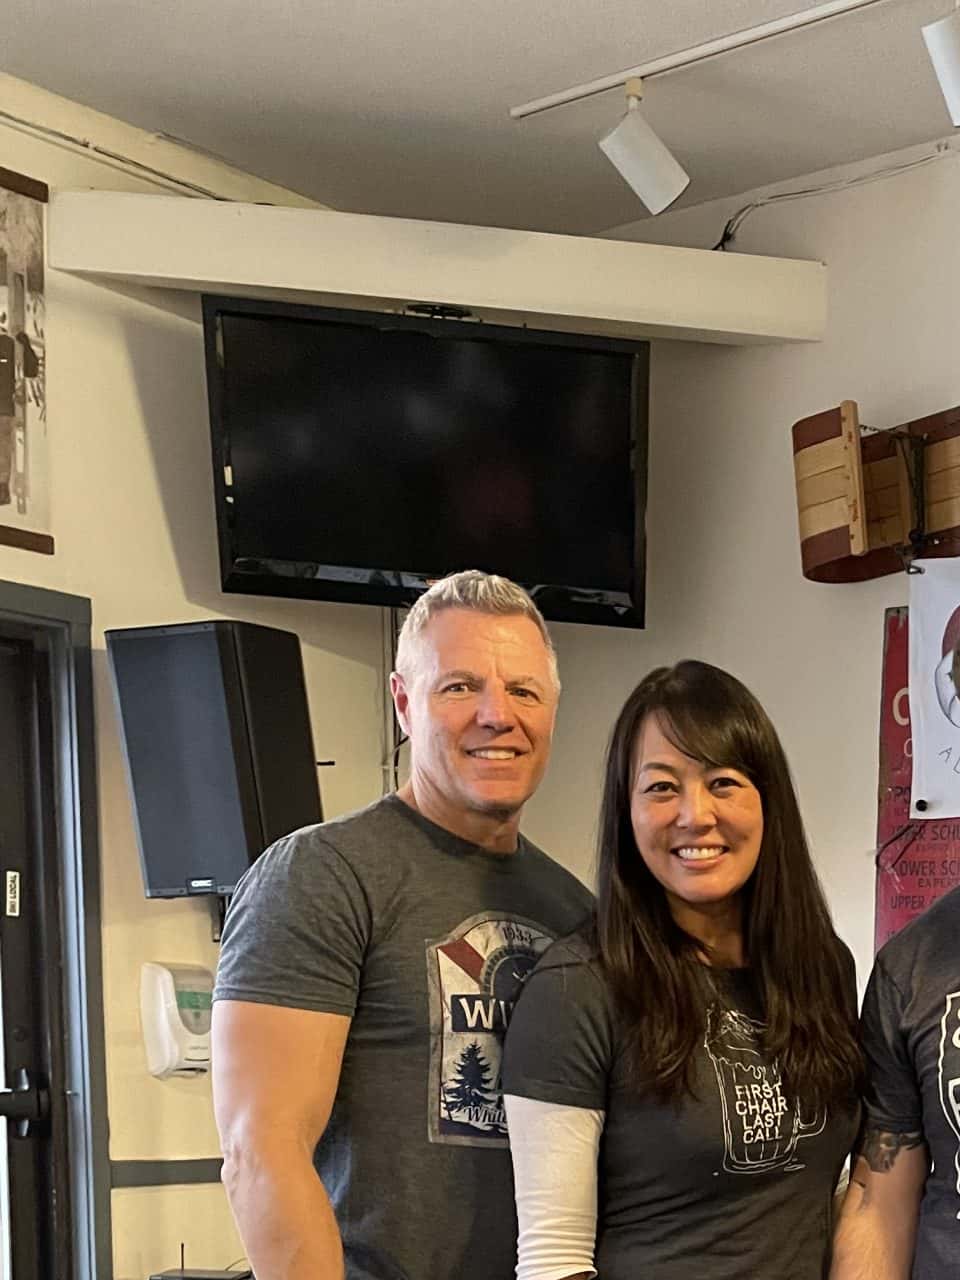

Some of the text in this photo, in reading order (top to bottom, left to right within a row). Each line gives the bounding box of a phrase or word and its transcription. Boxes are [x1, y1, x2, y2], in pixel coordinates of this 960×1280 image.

[735, 1081, 783, 1101] FIRST
[735, 1096, 789, 1117] CHAIR
[742, 1111, 785, 1130] LAST
[742, 1126, 784, 1145] CALL
